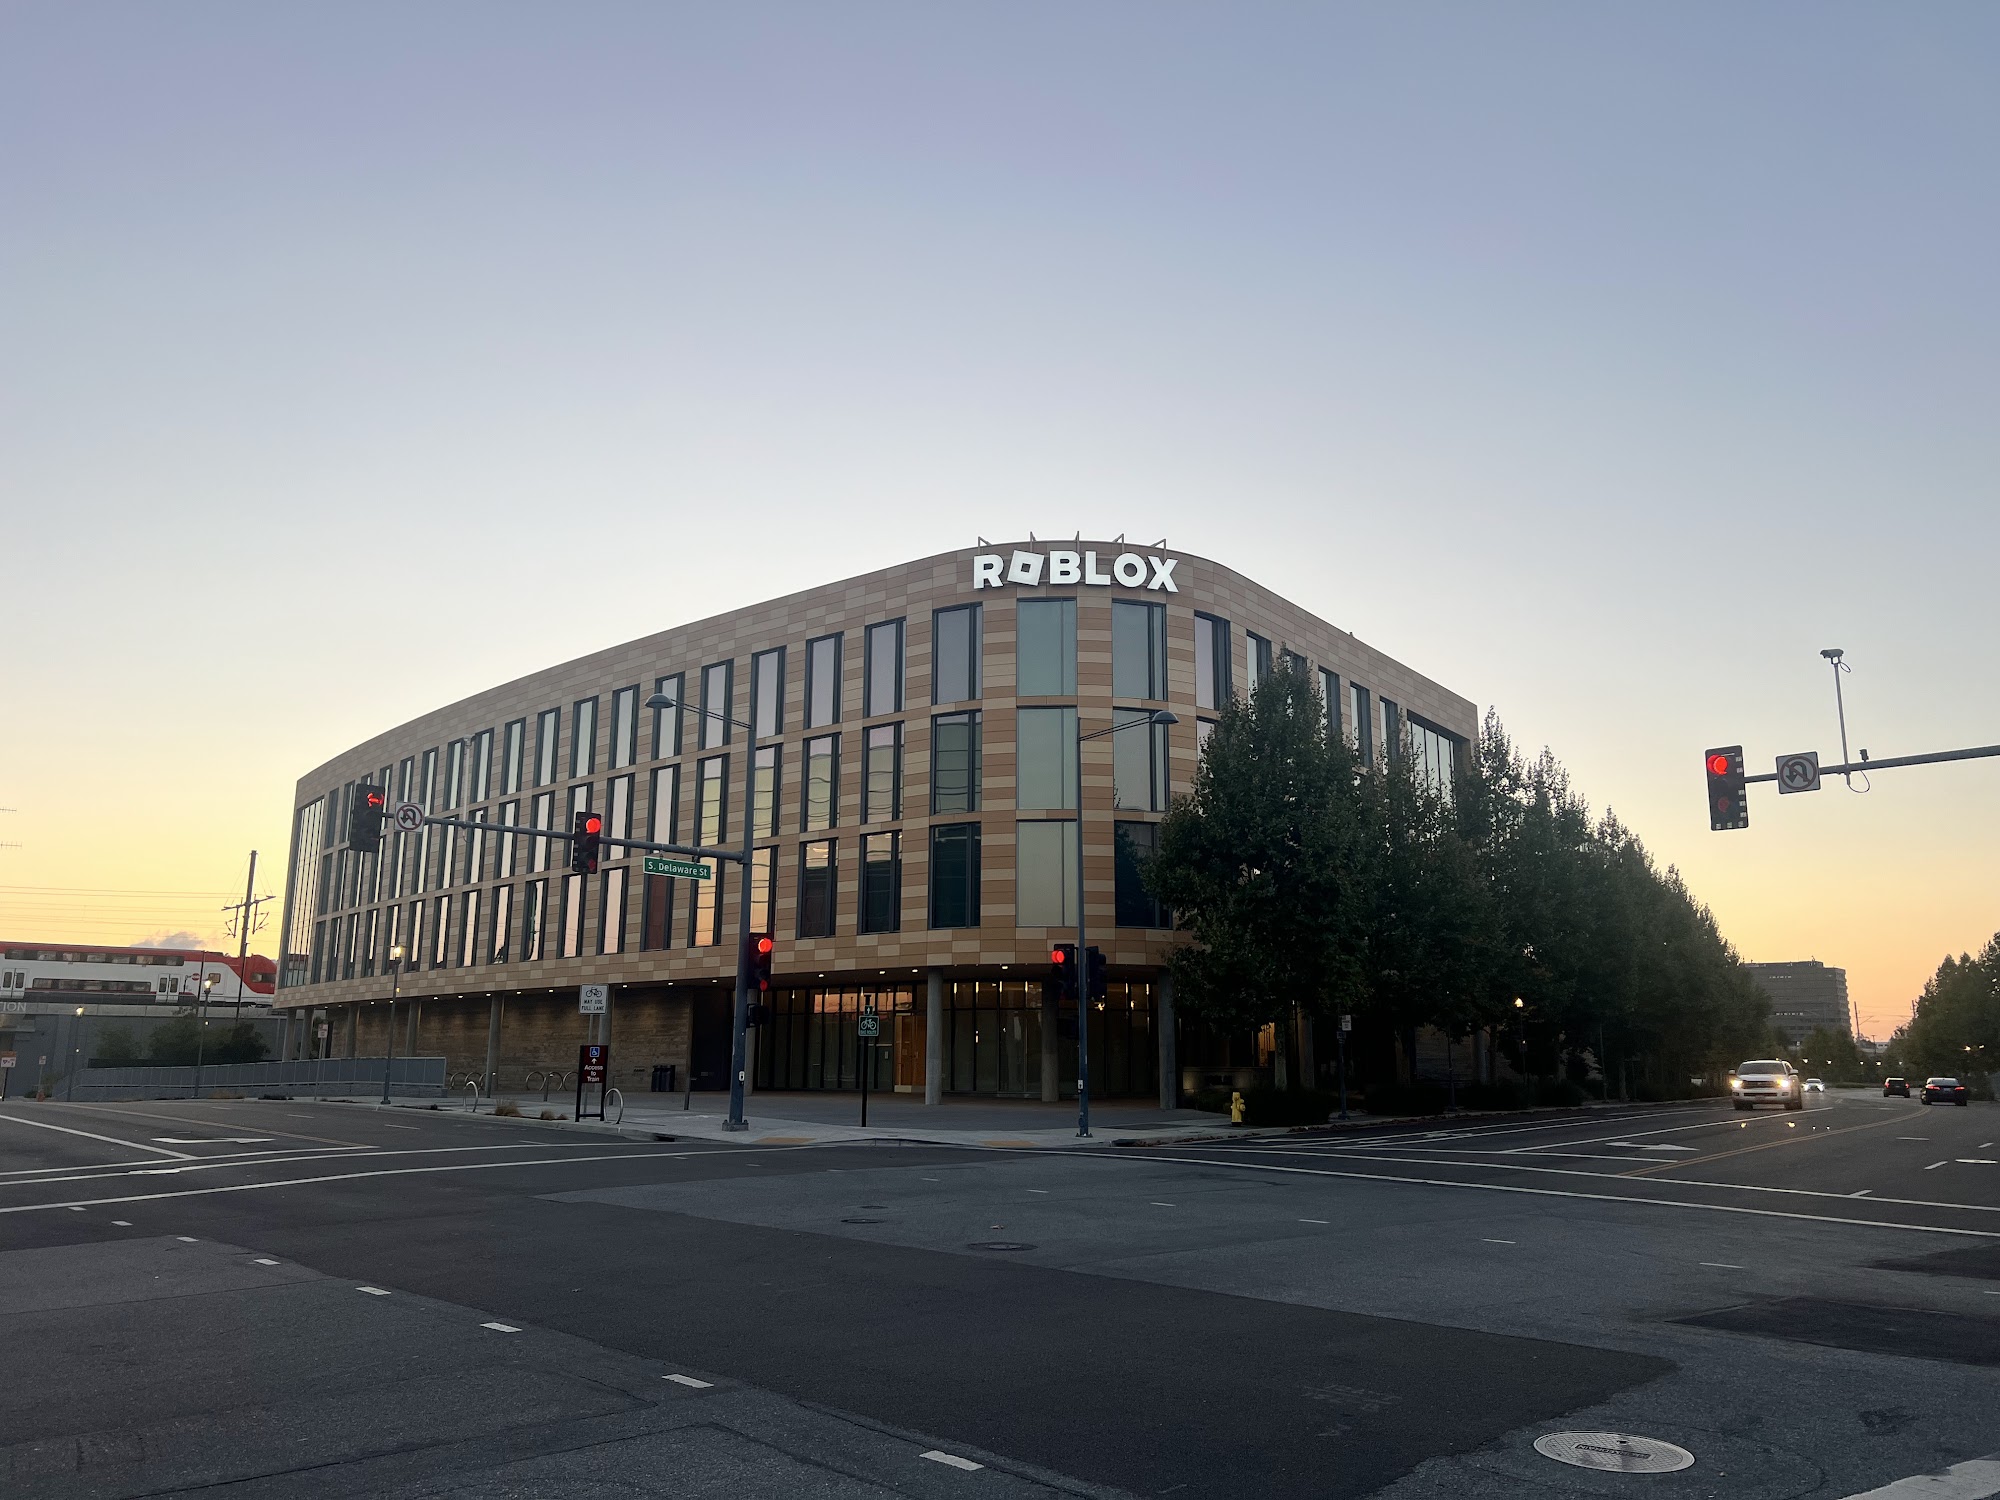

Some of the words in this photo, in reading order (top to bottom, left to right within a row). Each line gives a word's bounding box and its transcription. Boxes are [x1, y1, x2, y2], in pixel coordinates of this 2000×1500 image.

[973, 549, 1179, 593] ROBLOX
[648, 861, 656, 870] S.
[658, 862, 698, 875] Delaware
[699, 867, 708, 877] St
